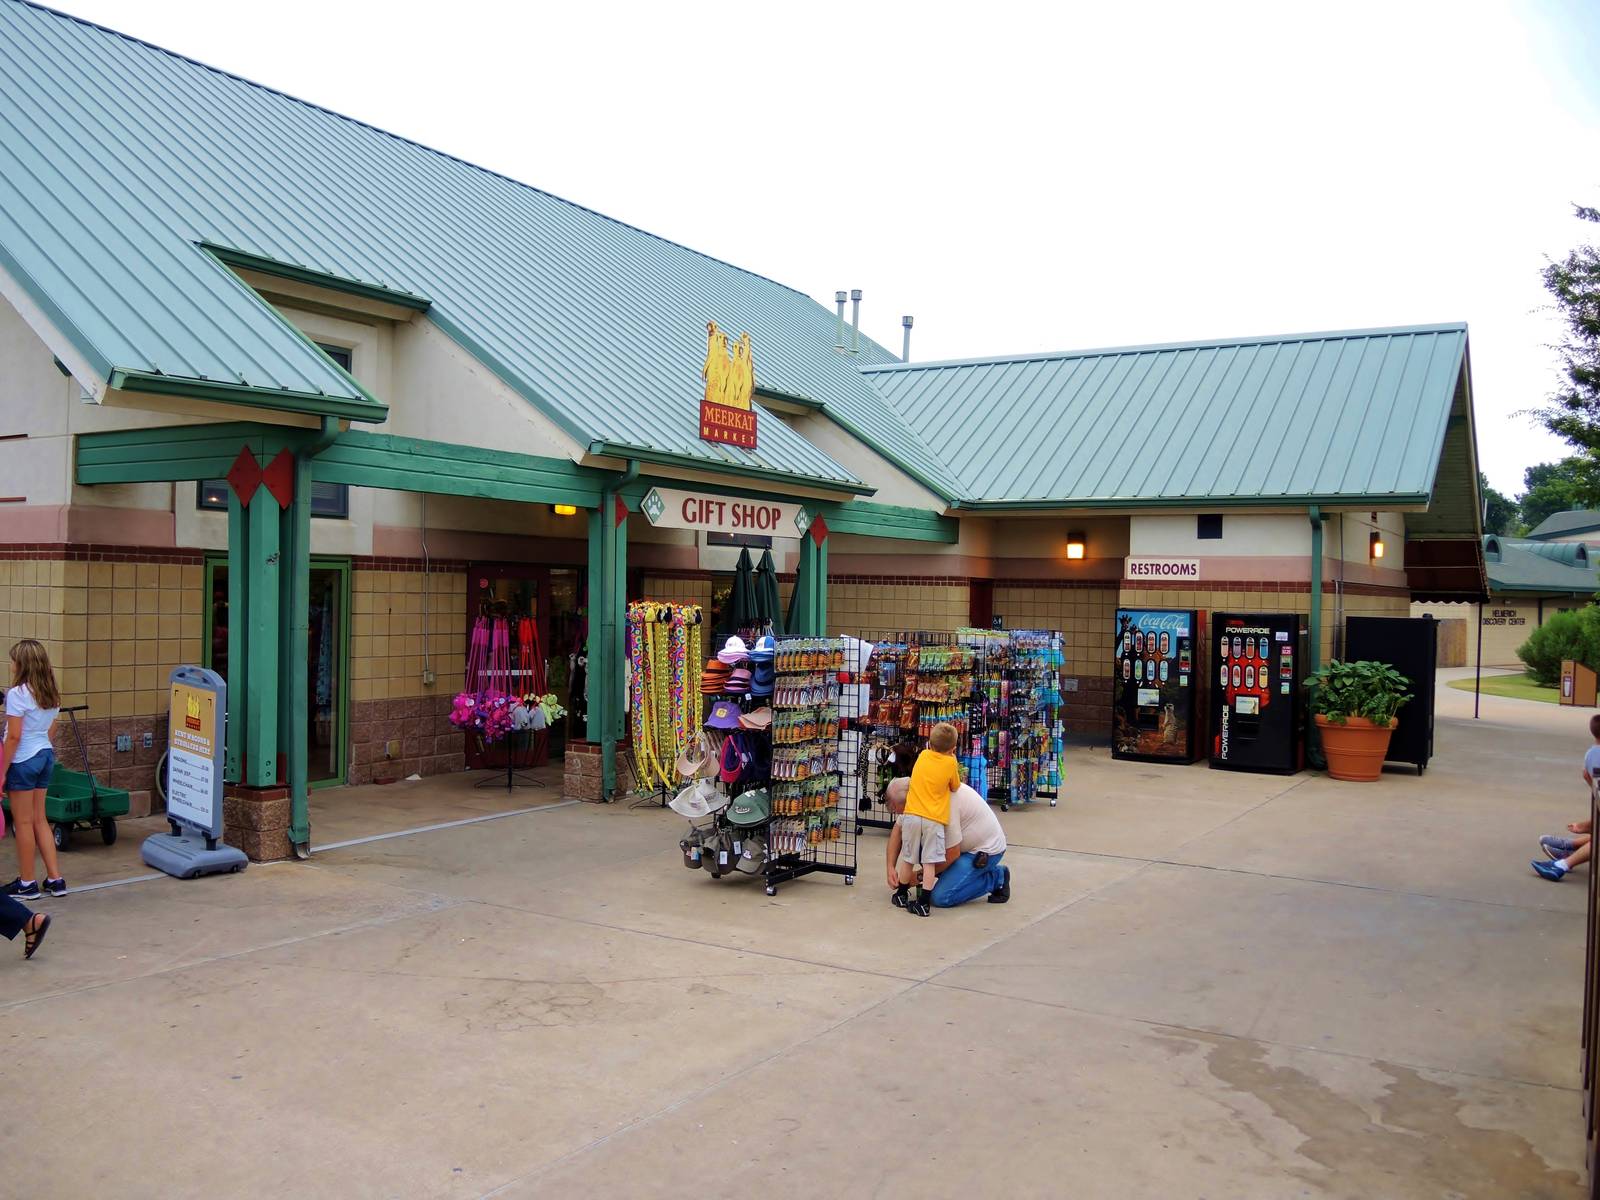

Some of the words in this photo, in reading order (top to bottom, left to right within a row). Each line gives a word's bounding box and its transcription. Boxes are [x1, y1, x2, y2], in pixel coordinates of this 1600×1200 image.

[704, 406, 755, 431] MEERKAT
[703, 427, 755, 445] MARKET
[682, 498, 726, 525] GIFT
[732, 503, 782, 530] SHOP
[1130, 563, 1197, 576] RESTROOMS
[1138, 613, 1186, 630] Coca-Cola
[1226, 626, 1270, 635] POWERADE
[1221, 705, 1230, 760] POWERADE
